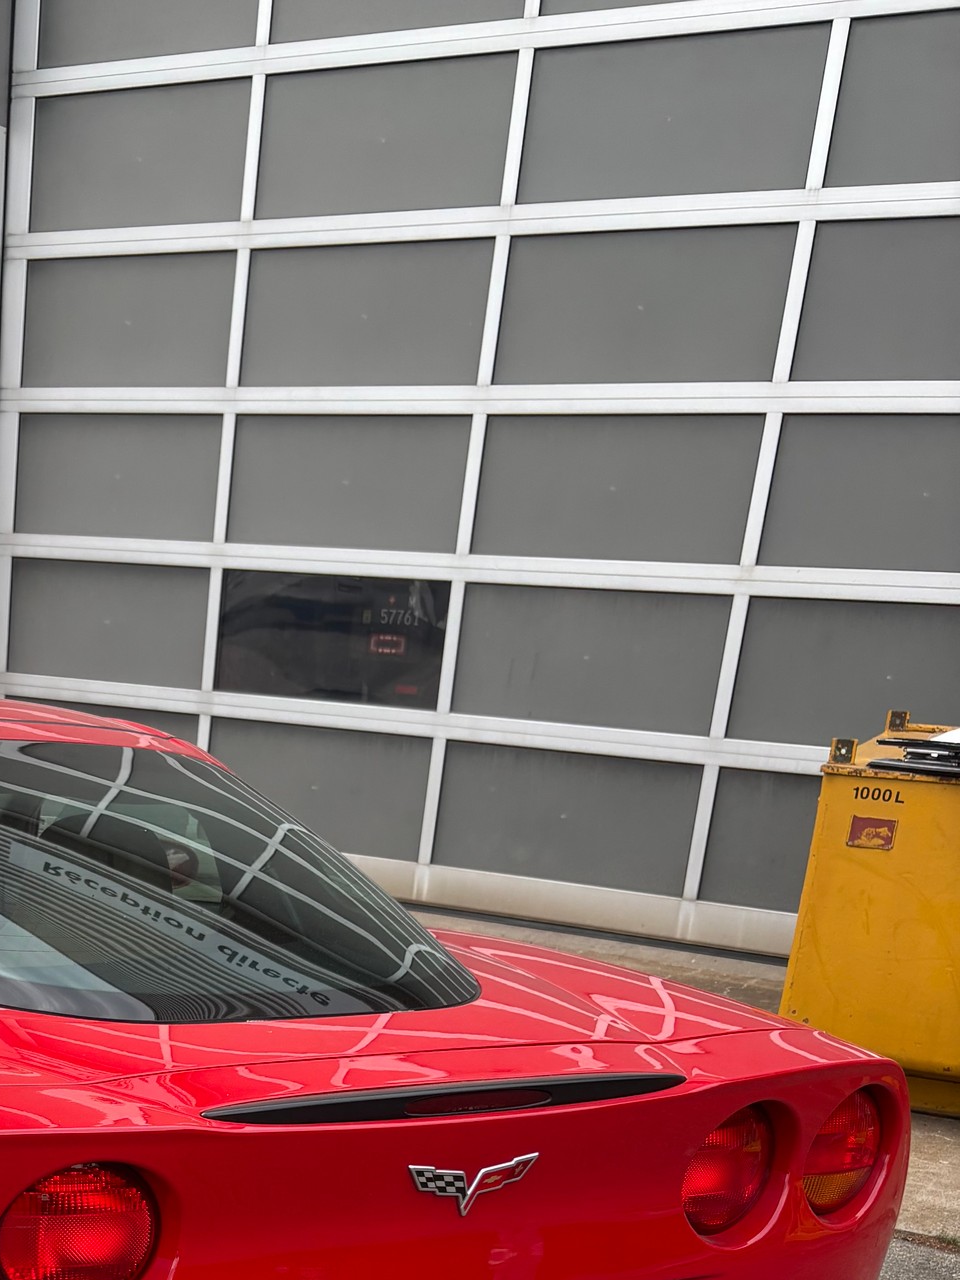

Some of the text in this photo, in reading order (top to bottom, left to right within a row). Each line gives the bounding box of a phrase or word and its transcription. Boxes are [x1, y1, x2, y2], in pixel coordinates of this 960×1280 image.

[380, 608, 419, 626] 57761
[853, 786, 905, 804] 1000 L
